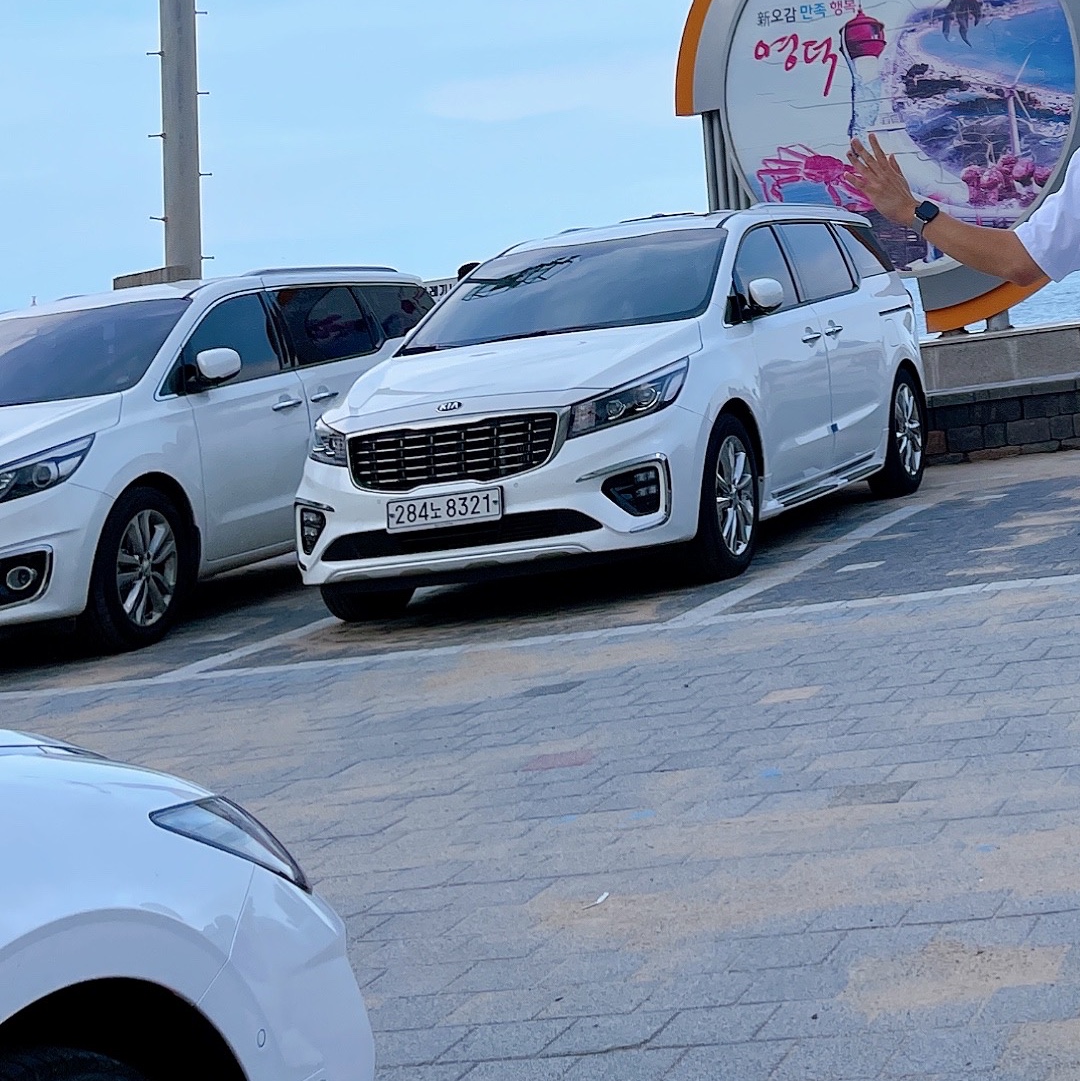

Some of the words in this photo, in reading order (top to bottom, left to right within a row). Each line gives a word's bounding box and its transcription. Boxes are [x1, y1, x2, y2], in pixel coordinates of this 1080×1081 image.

[799, 2, 827, 20] 만족
[754, 33, 838, 98] 영덕
[438, 400, 461, 411] KIA
[395, 502, 441, 525] 284노
[446, 493, 491, 518] 8321
